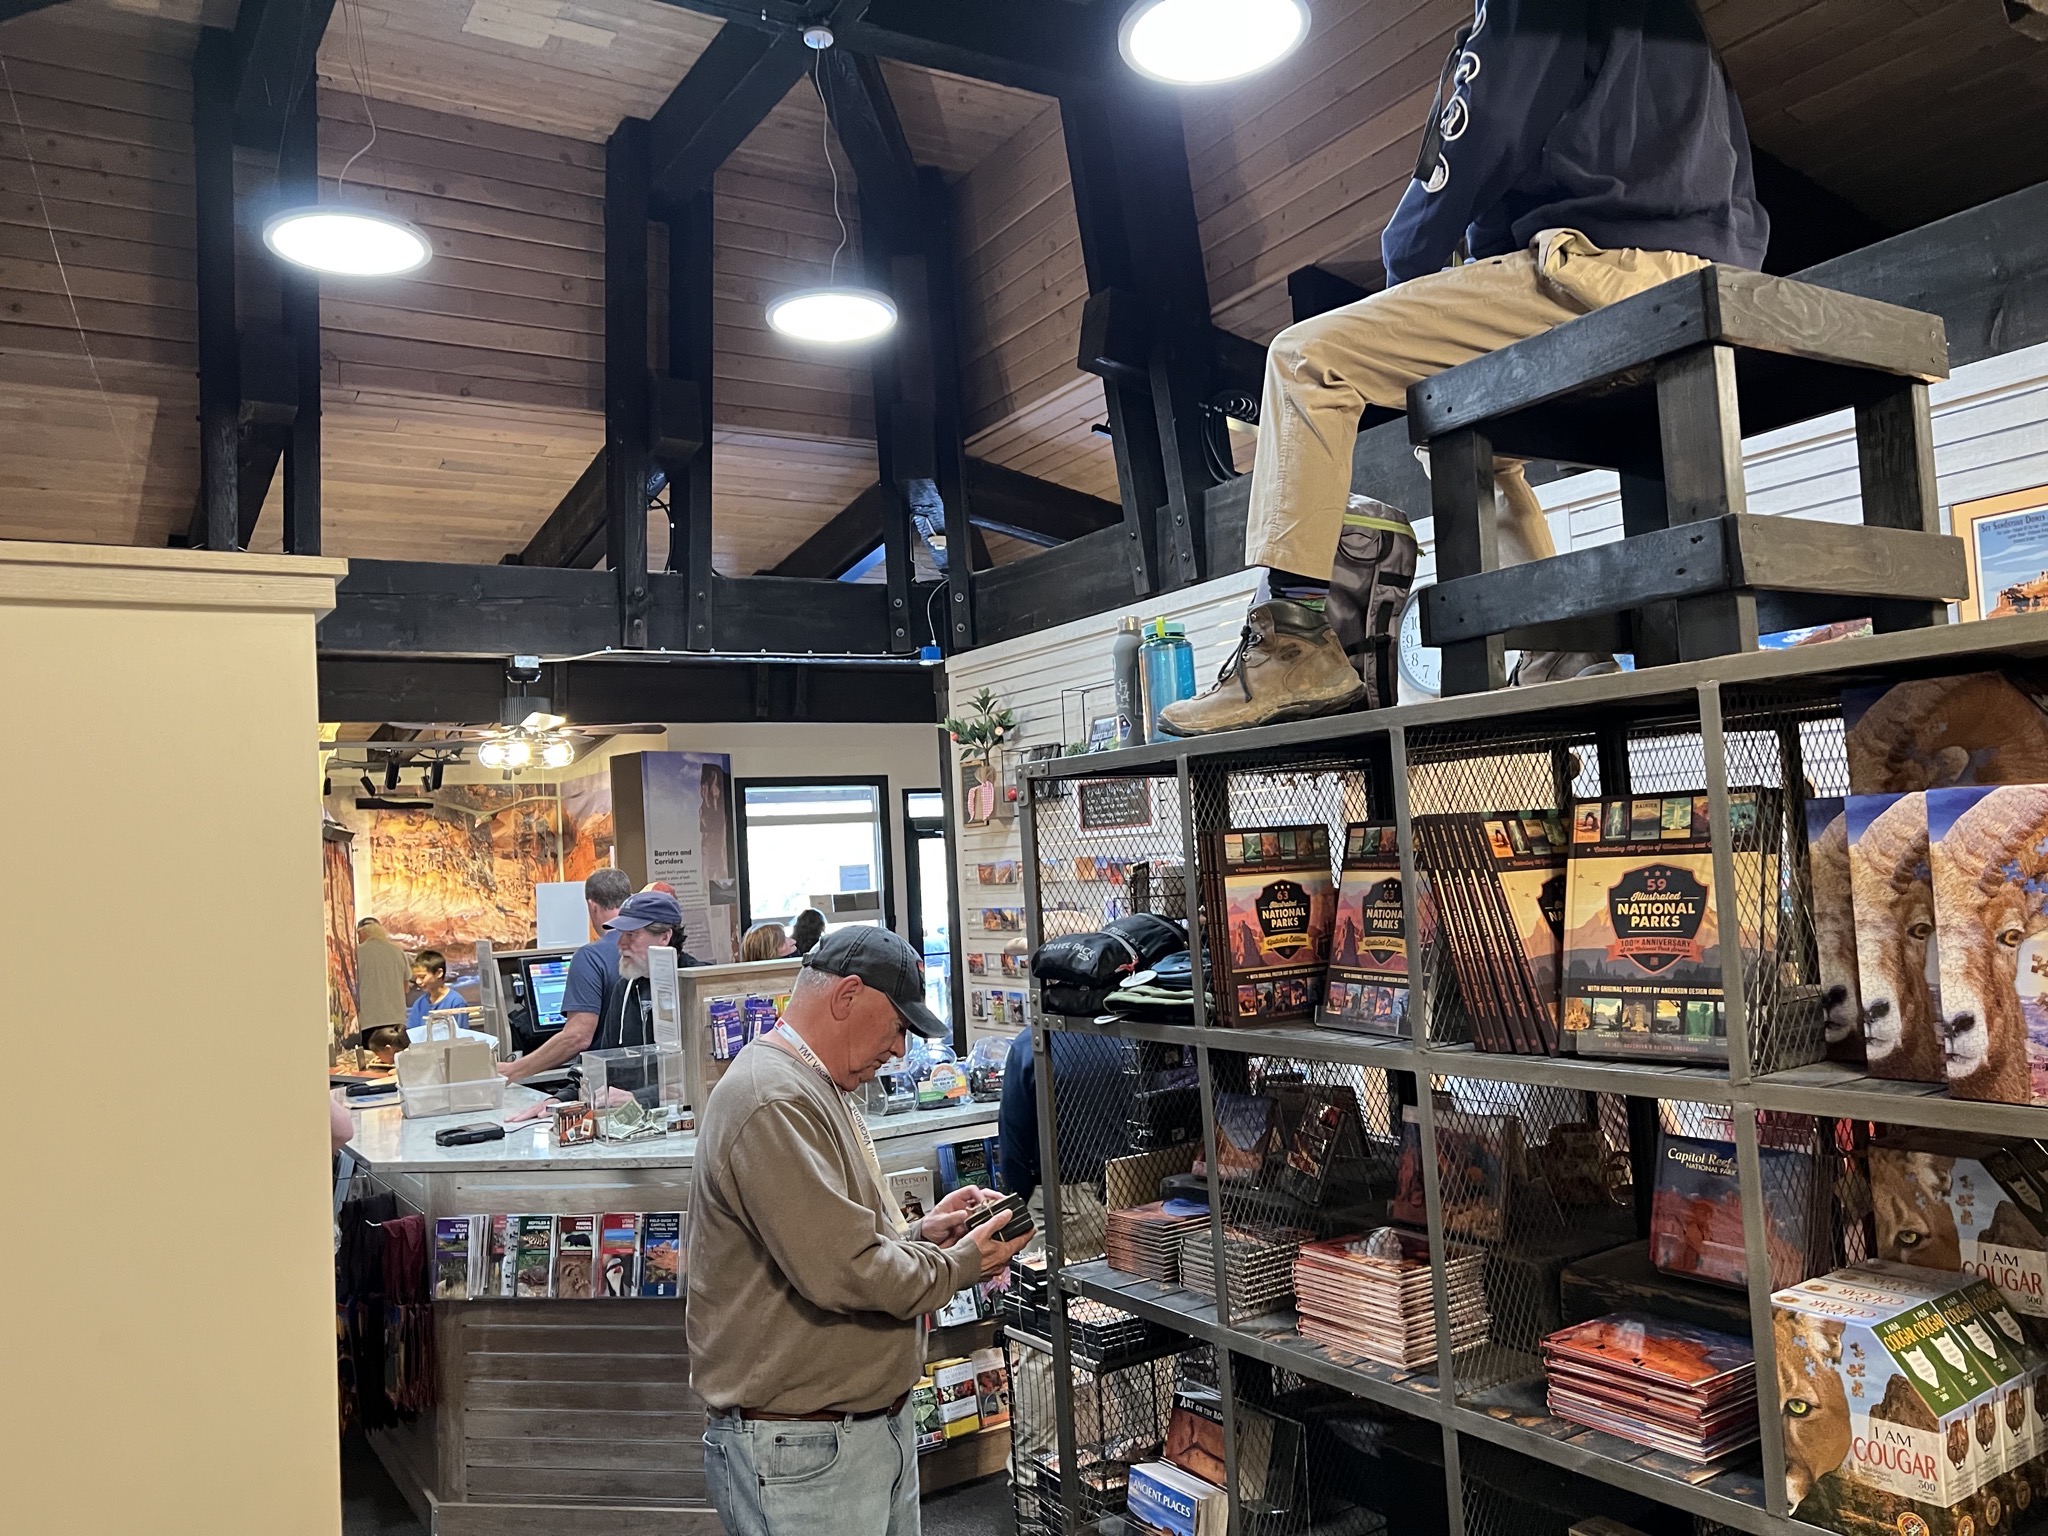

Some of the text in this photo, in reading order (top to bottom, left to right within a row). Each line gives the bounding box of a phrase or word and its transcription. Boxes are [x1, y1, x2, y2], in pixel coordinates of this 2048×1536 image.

[1405, 634, 1414, 649] 9
[1411, 652, 1419, 667] 8
[1422, 664, 1430, 680] 7
[654, 848, 692, 857] Barriers and
[1647, 878, 1667, 891] 59
[1276, 890, 1289, 900] 63
[1384, 889, 1395, 899] 63
[1630, 891, 1682, 902] Illustrated
[1262, 907, 1306, 919] NATIONAL
[1366, 909, 1403, 919] NATIONA
[1617, 902, 1696, 915] NATIONAL
[1271, 917, 1299, 928] PARKS
[1373, 919, 1399, 929] PARKS
[1630, 915, 1681, 928] PARKS
[1641, 938, 1691, 947] ANNIVERSARY
[1043, 941, 1096, 958] TRAVEL PACK
[1600, 985, 1622, 993] ORIGINAL
[1653, 986, 1660, 994] BY
[799, 1044, 815, 1062] YMT
[850, 1106, 872, 1147] Vacations
[1667, 1147, 1733, 1169] Capitol Reef
[1685, 1162, 1737, 1176] NATIONAL PARK
[890, 1175, 928, 1187] Peterson
[1983, 1249, 2019, 1267] I AM
[1916, 1308, 1929, 1320] AM
[1944, 1301, 1976, 1326] COUGAR
[1887, 1321, 1901, 1332] AM
[1913, 1313, 1947, 1339] COUGAR
[1883, 1328, 1920, 1353] COUGAR
[1180, 1396, 1195, 1409] ART
[1874, 1426, 1912, 1448] I AM
[1853, 1436, 1938, 1482] COUGAR
[1918, 1479, 1936, 1492] 300
[1133, 1479, 1191, 1518] ANCIENT PLACES
